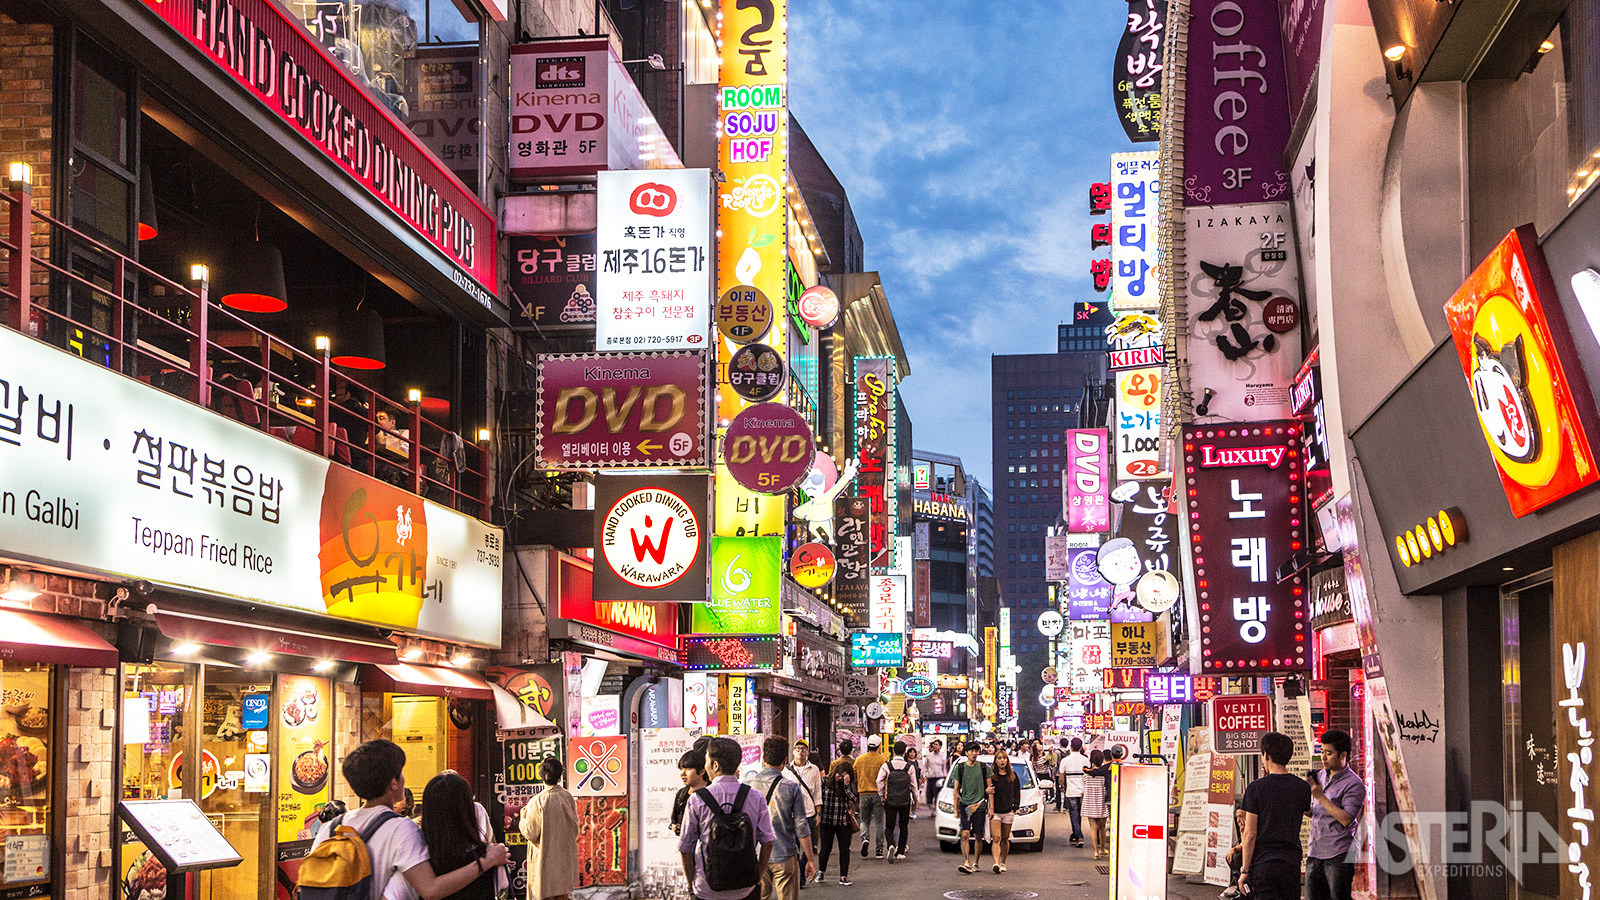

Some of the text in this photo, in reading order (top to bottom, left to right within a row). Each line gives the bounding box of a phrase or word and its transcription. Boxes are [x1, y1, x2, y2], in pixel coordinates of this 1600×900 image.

[1127, 0, 1164, 88] 락방
[537, 56, 584, 65] DIGITAL
[540, 64, 581, 81] dts
[537, 81, 585, 89] SURROUND
[515, 90, 601, 107] Kinema
[723, 87, 782, 109] ROOM
[512, 112, 605, 134] DVD
[727, 112, 778, 135] SOJU
[192, 0, 475, 270] HAND COOKED DINING PUB
[517, 140, 597, 157] 영화관 5F
[731, 140, 773, 162] HOF
[1222, 167, 1253, 189] 3F
[1197, 215, 1284, 228] IZAKAYA
[669, 227, 686, 239] 직영
[1260, 231, 1286, 250] 2F
[518, 249, 597, 273] 당구 클럽
[603, 246, 706, 274] 제주16돈가
[521, 274, 589, 285] BILLIARD CLUB
[622, 289, 684, 303] 제주 흑돼지
[730, 291, 757, 303] 이레
[520, 302, 545, 321] 4F
[662, 305, 694, 319] 전문점
[719, 304, 768, 323] 부동산
[1077, 310, 1090, 320] SK
[606, 335, 632, 345] 종로본점
[647, 334, 684, 344] 720-5917
[688, 335, 702, 343] 3F
[734, 326, 750, 336] 1F
[1111, 347, 1164, 367] KIRIN
[584, 366, 650, 381] Kinema
[731, 372, 780, 386] 당구클럽
[749, 387, 762, 396] 4F
[1126, 373, 1162, 406] 왕
[552, 384, 687, 435] DVD
[864, 372, 886, 440] Praha
[744, 417, 795, 429] Kinema
[856, 392, 869, 439] 프라하
[561, 441, 632, 457] 엘리베이터 이용
[672, 439, 690, 453] 5F
[731, 435, 808, 464] DVD
[1074, 431, 1101, 494] DVD
[1202, 446, 1285, 467] Luxury
[132, 427, 284, 525] 철판볶음밥
[757, 472, 780, 486] 5F
[931, 492, 950, 504] BAR
[1072, 495, 1105, 507] 상영관
[25, 489, 79, 531] Galbi
[914, 499, 967, 520] HABANA
[604, 492, 698, 546] HAND COOKED DINING PUB
[132, 517, 273, 575] Teppan Fried Rice
[1228, 478, 1271, 644] 노래방
[620, 563, 684, 583] WARAWARA
[836, 583, 869, 591] IZAKAYA
[733, 598, 772, 610] WATER
[876, 577, 897, 634] 종로고기
[1121, 625, 1146, 639] 하나
[1116, 641, 1152, 656] 부동산
[1113, 657, 1156, 666] T.720-3335
[1115, 702, 1147, 715] DVD
[1223, 703, 1261, 714] VENTI
[1219, 715, 1266, 730] COFFEE
[1107, 733, 1138, 744] Luxury
[1225, 731, 1258, 740] BIG SIZE
[509, 740, 556, 761] 10분당
